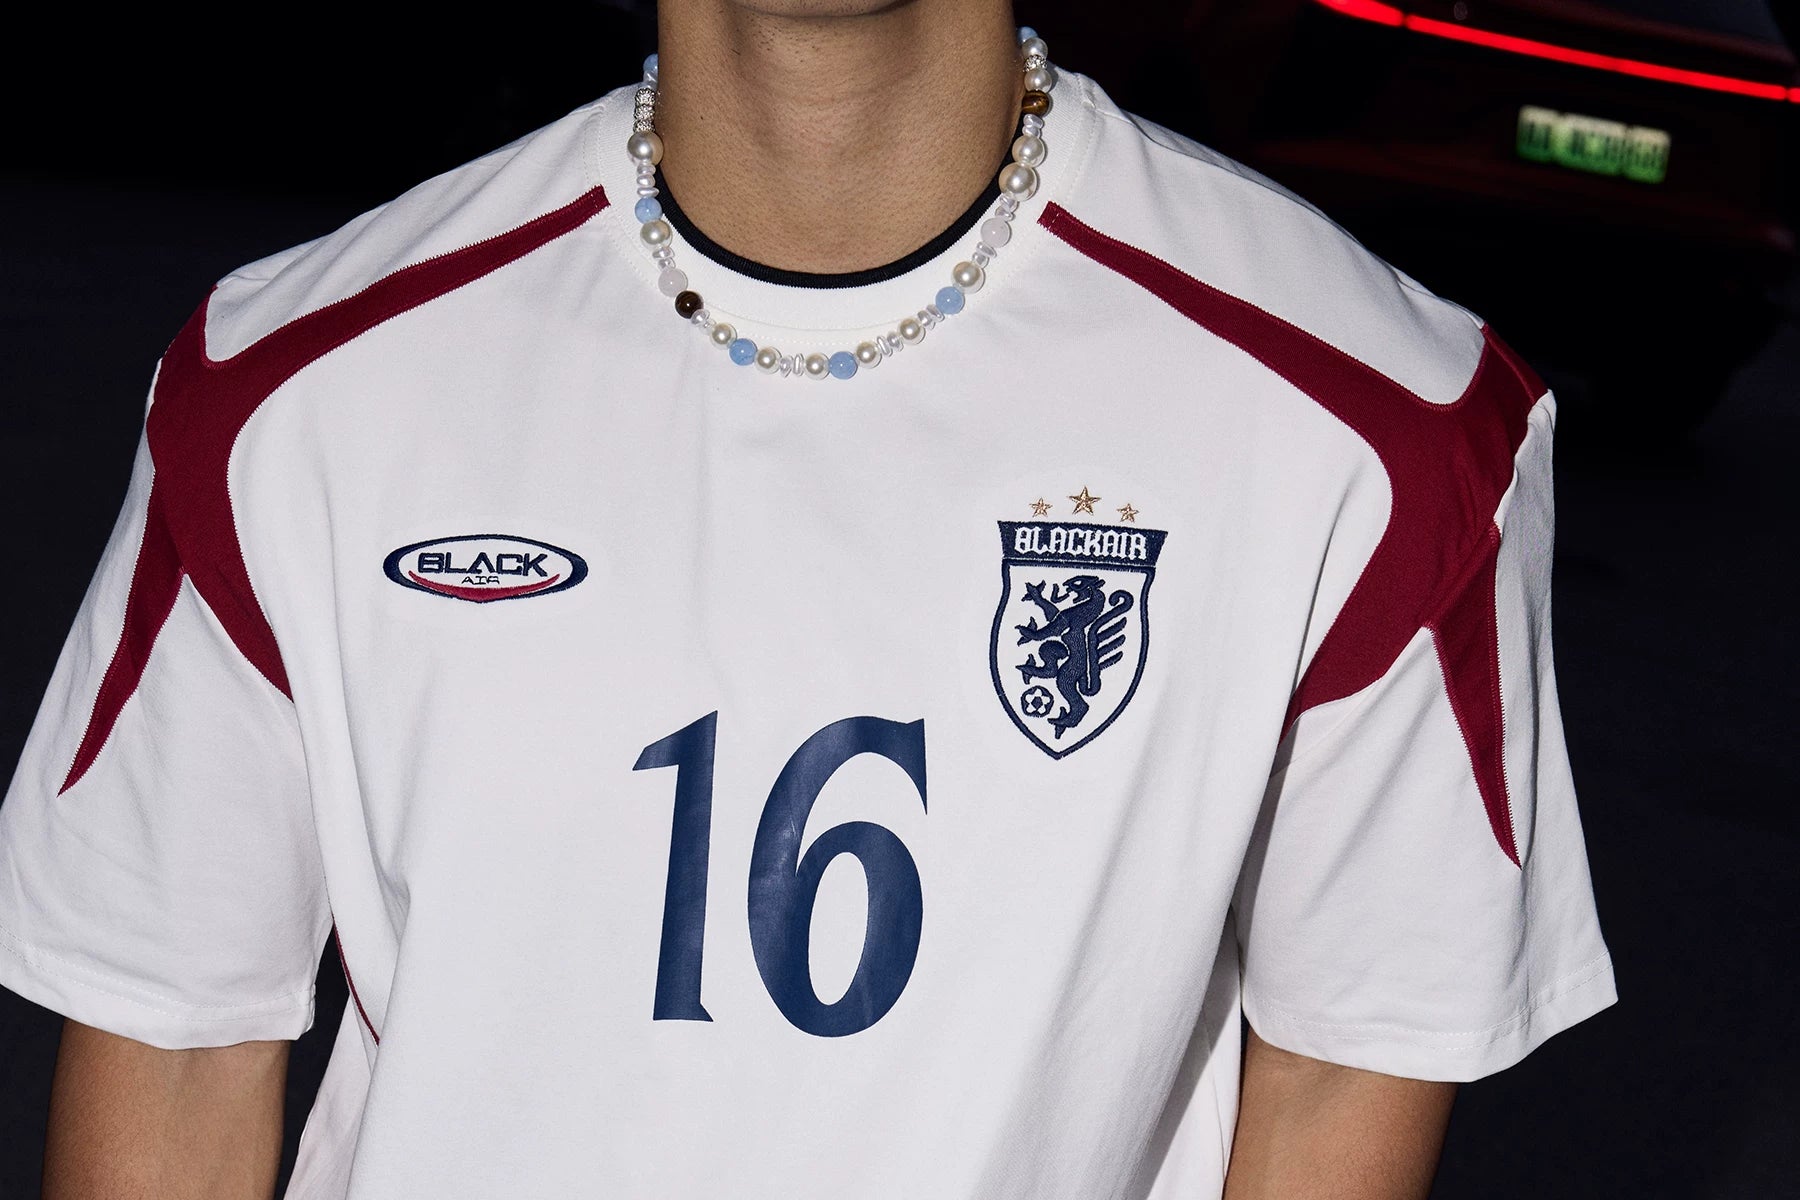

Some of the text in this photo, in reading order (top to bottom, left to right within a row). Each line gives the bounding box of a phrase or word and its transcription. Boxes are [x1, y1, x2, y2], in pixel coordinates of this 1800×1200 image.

[1014, 526, 1147, 560] BLACKAIR
[417, 552, 548, 577] BLACK
[461, 575, 501, 585] AIR
[632, 710, 928, 1038] 16
